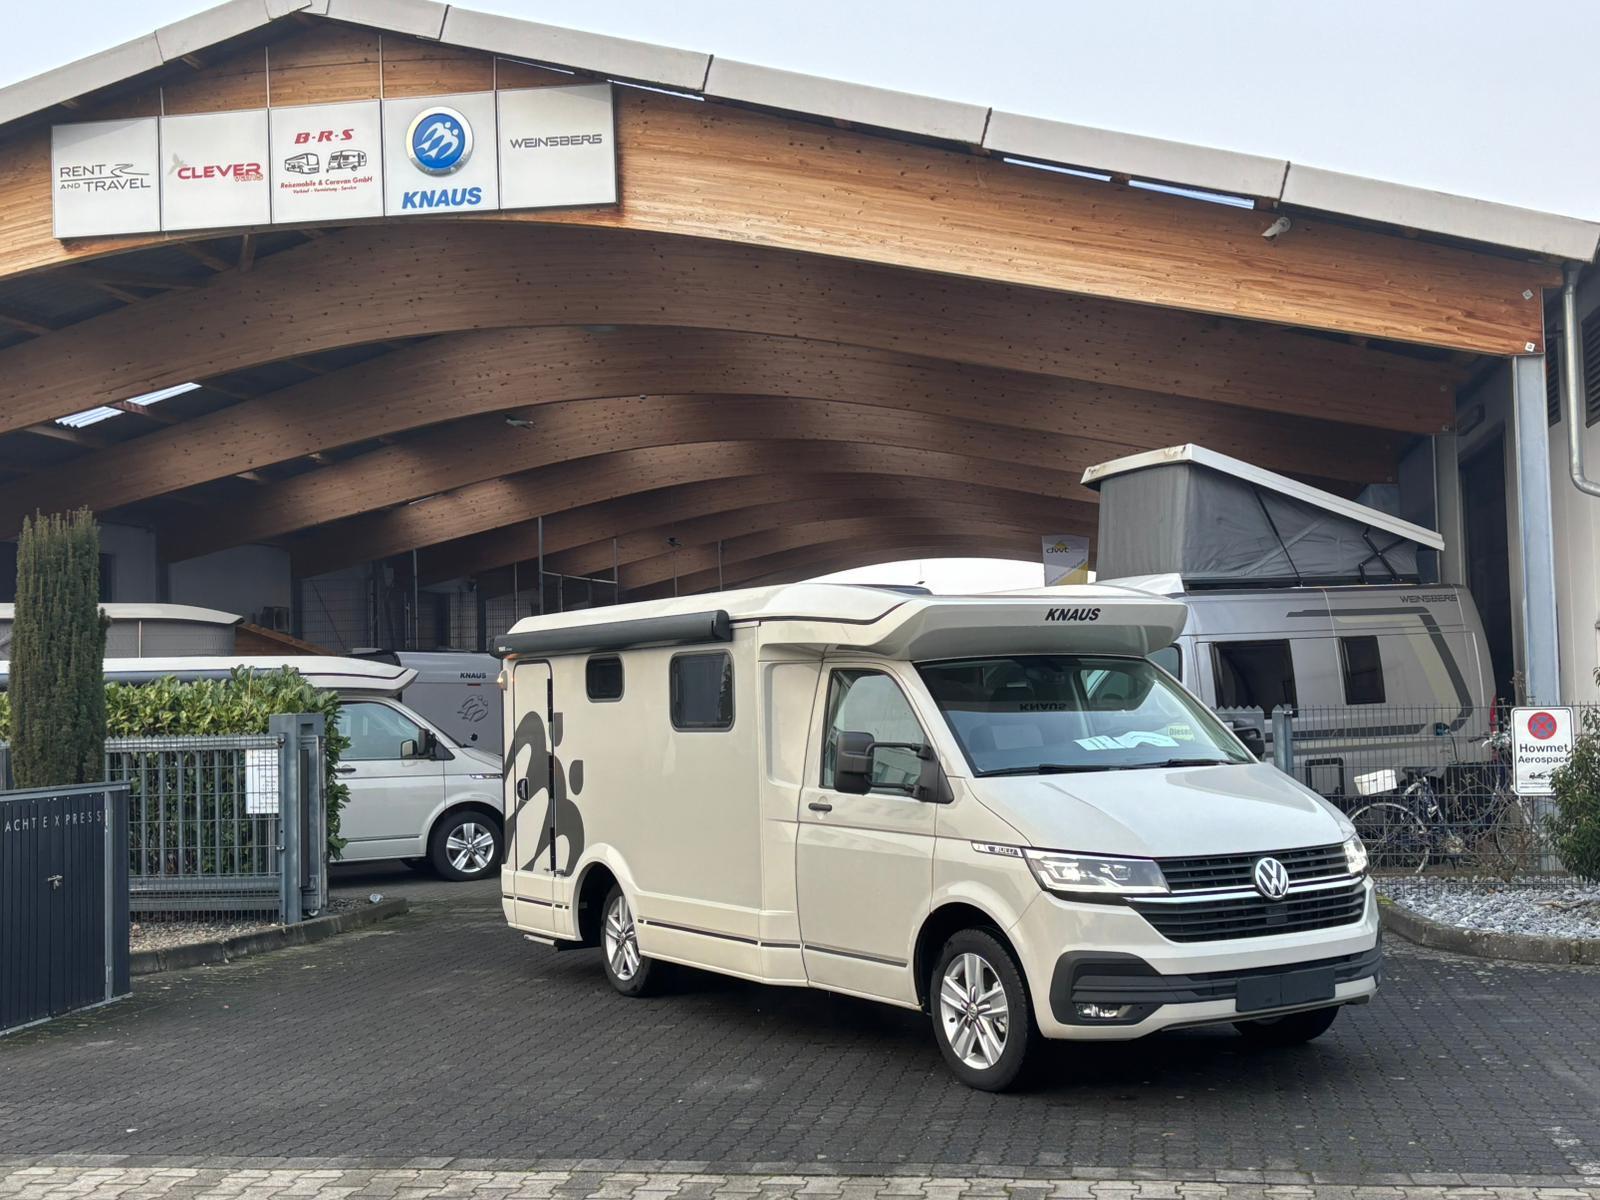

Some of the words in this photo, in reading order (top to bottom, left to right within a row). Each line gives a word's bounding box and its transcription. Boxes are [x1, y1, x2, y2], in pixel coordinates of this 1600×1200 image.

[509, 133, 603, 149] WEINSBERG
[60, 164, 106, 178] RENT
[177, 162, 261, 180] CLEVER
[60, 182, 81, 190] AND
[83, 177, 151, 192] TRAVEL
[325, 178, 351, 186] Caravan
[352, 176, 373, 184] GmbH
[401, 186, 482, 210] KNAUS
[1044, 607, 1101, 621] KNAUS
[1519, 743, 1569, 753] Howmet
[1518, 755, 1571, 765] Aerospace
